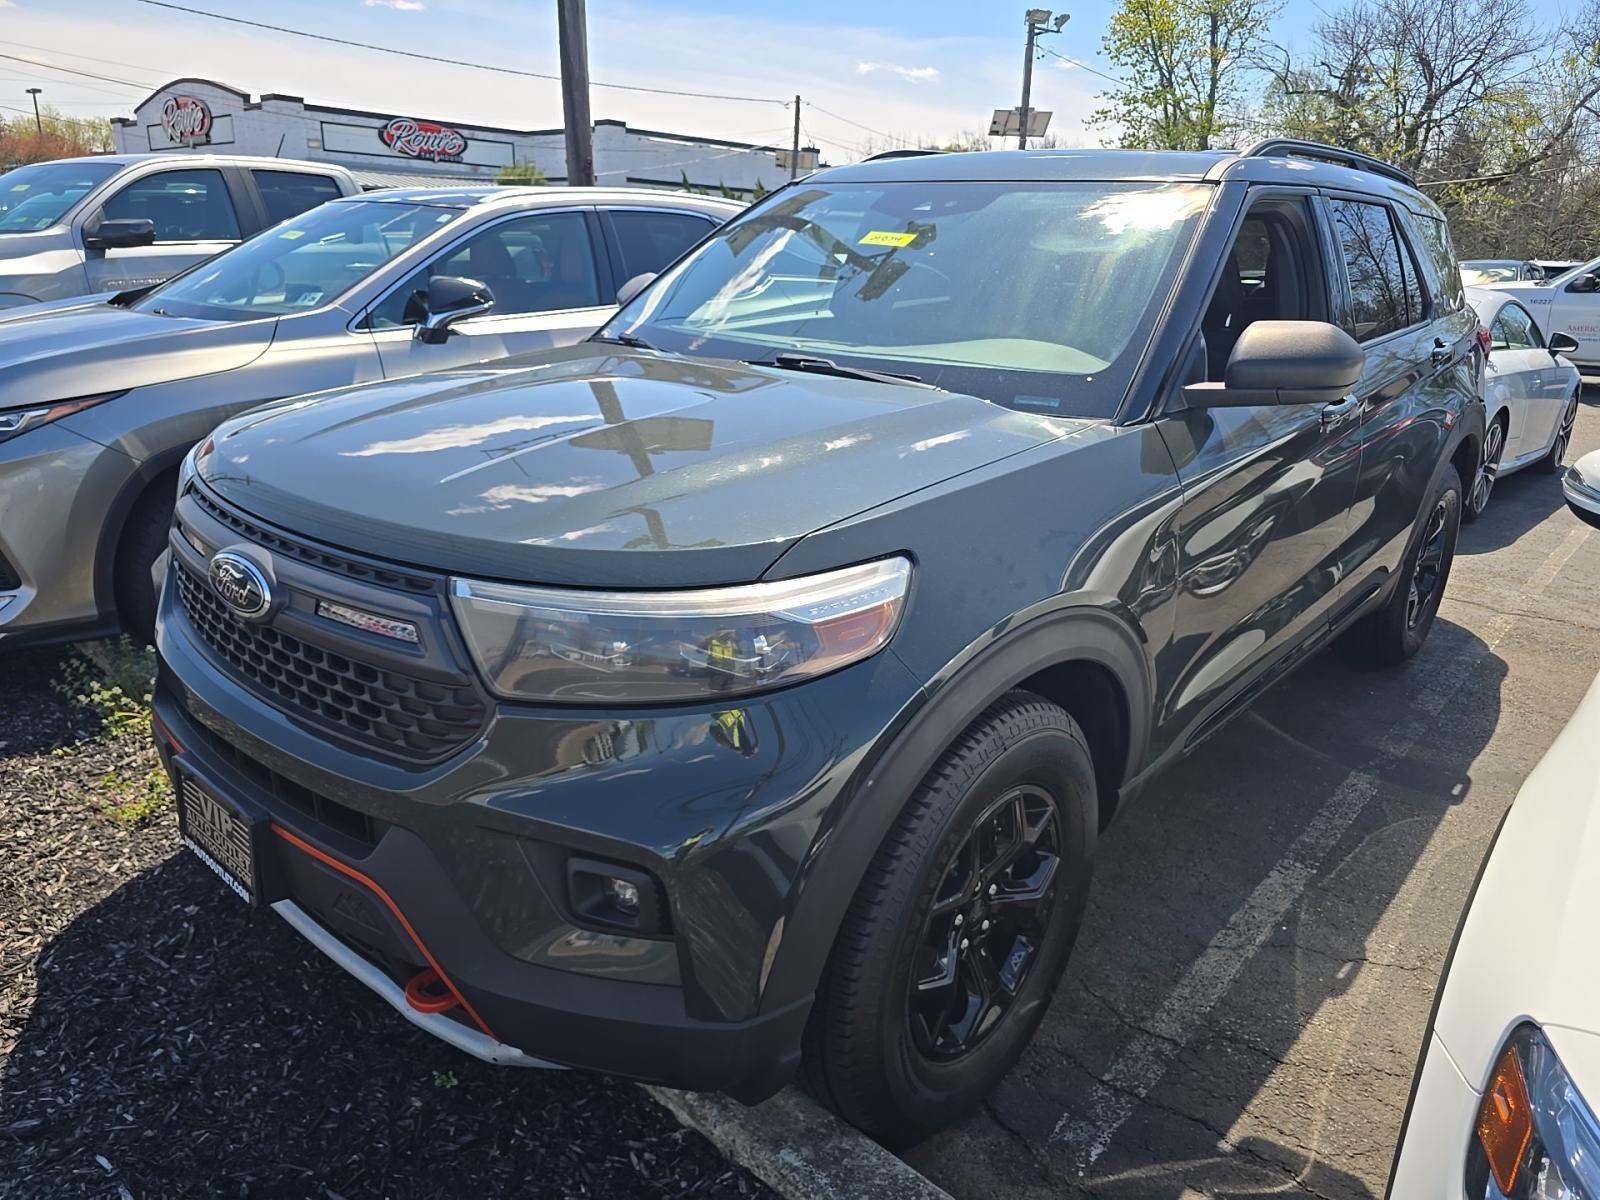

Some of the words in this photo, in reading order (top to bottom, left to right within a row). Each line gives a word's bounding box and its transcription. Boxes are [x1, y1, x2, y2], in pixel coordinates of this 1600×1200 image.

[386, 117, 464, 156] Roni's
[216, 562, 251, 605] Ford
[199, 789, 234, 837] VIP
[187, 808, 212, 838] AUTO
[213, 831, 251, 873] OUTLET
